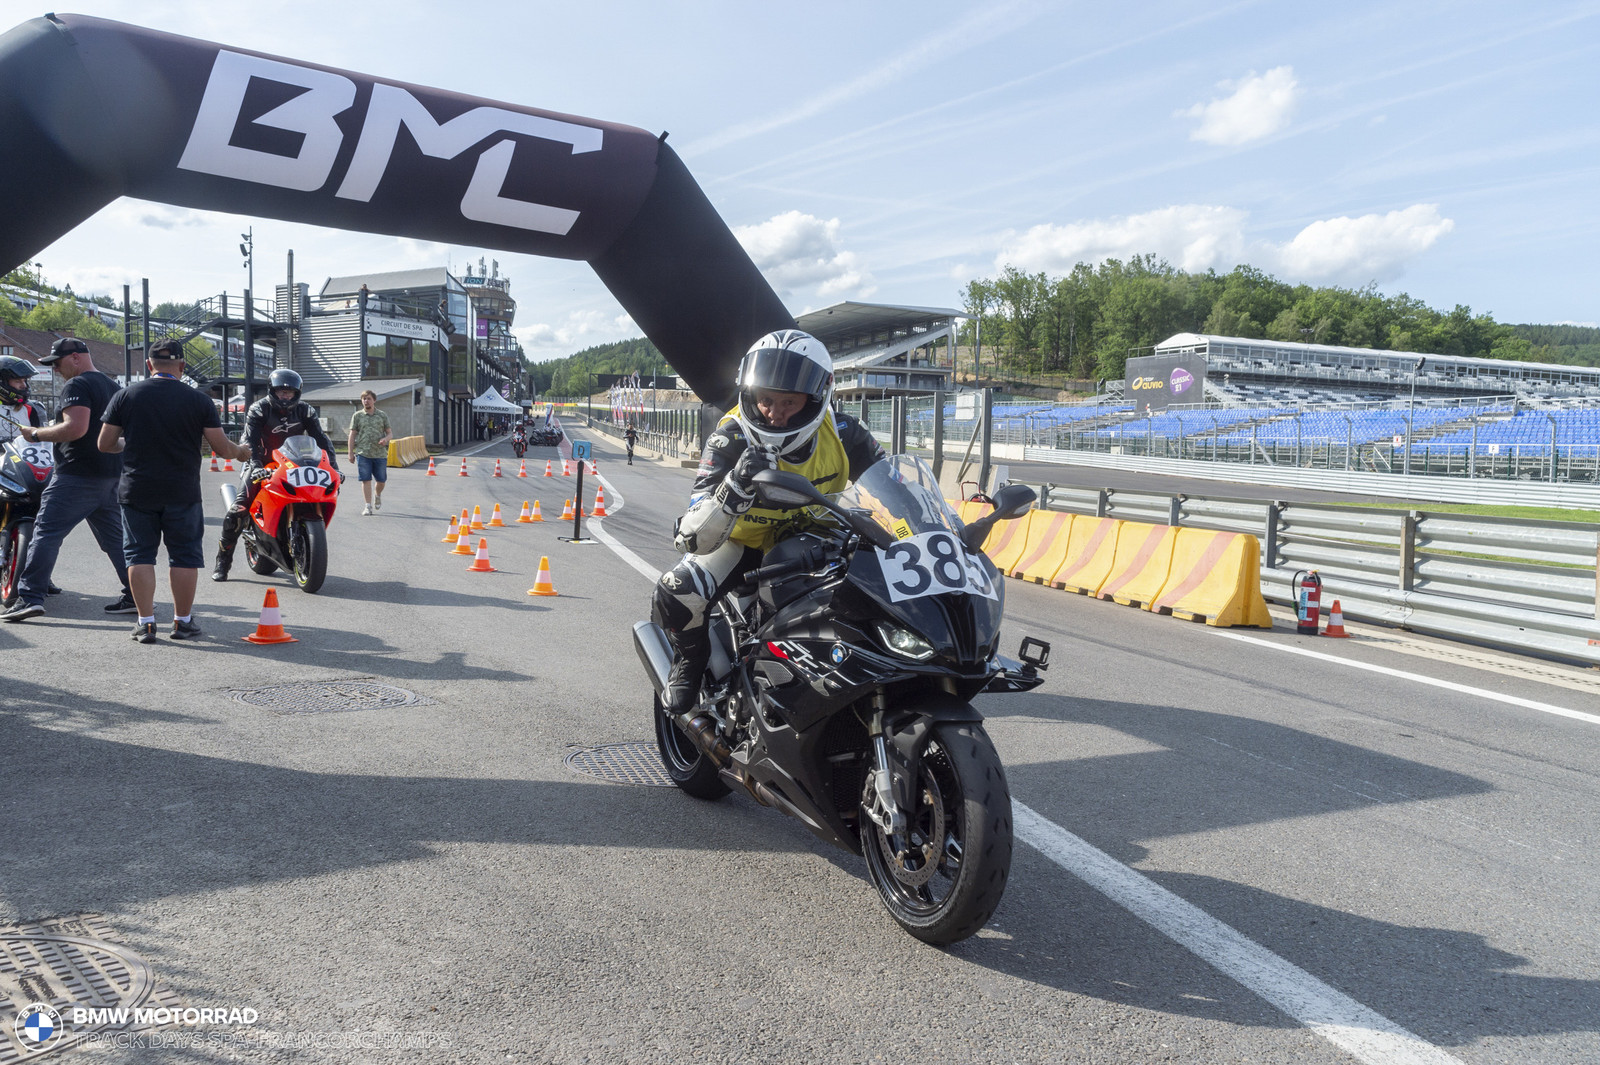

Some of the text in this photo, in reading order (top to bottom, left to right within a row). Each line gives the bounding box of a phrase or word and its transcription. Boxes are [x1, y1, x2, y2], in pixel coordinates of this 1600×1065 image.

[177, 49, 603, 235] BMC
[381, 320, 402, 328] CIRCUIT
[577, 445, 585, 456] D
[290, 467, 330, 487] 102
